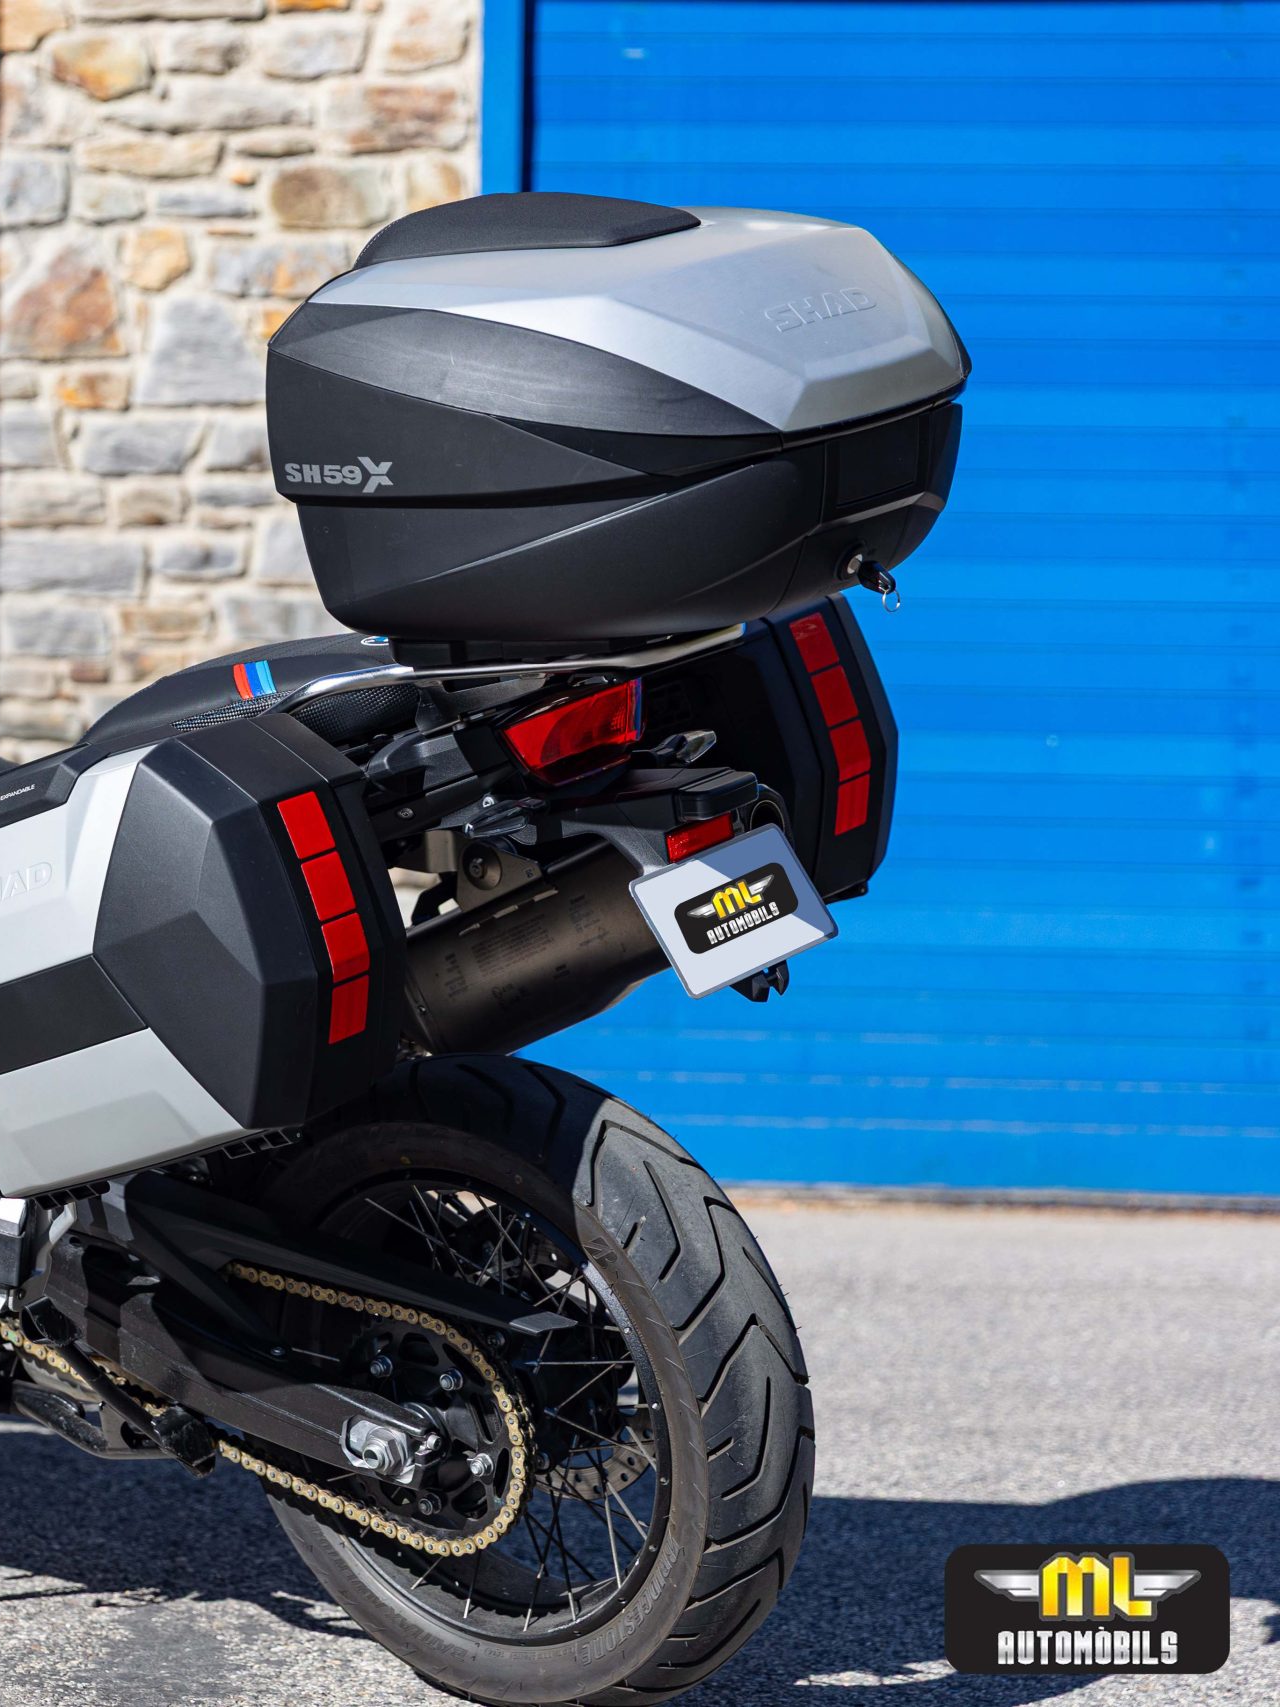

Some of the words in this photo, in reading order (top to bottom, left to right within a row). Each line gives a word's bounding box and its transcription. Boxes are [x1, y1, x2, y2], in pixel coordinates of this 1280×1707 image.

[764, 287, 877, 332] SHAD
[284, 456, 394, 493] SH59X
[0, 783, 35, 801] EXPANDABLE
